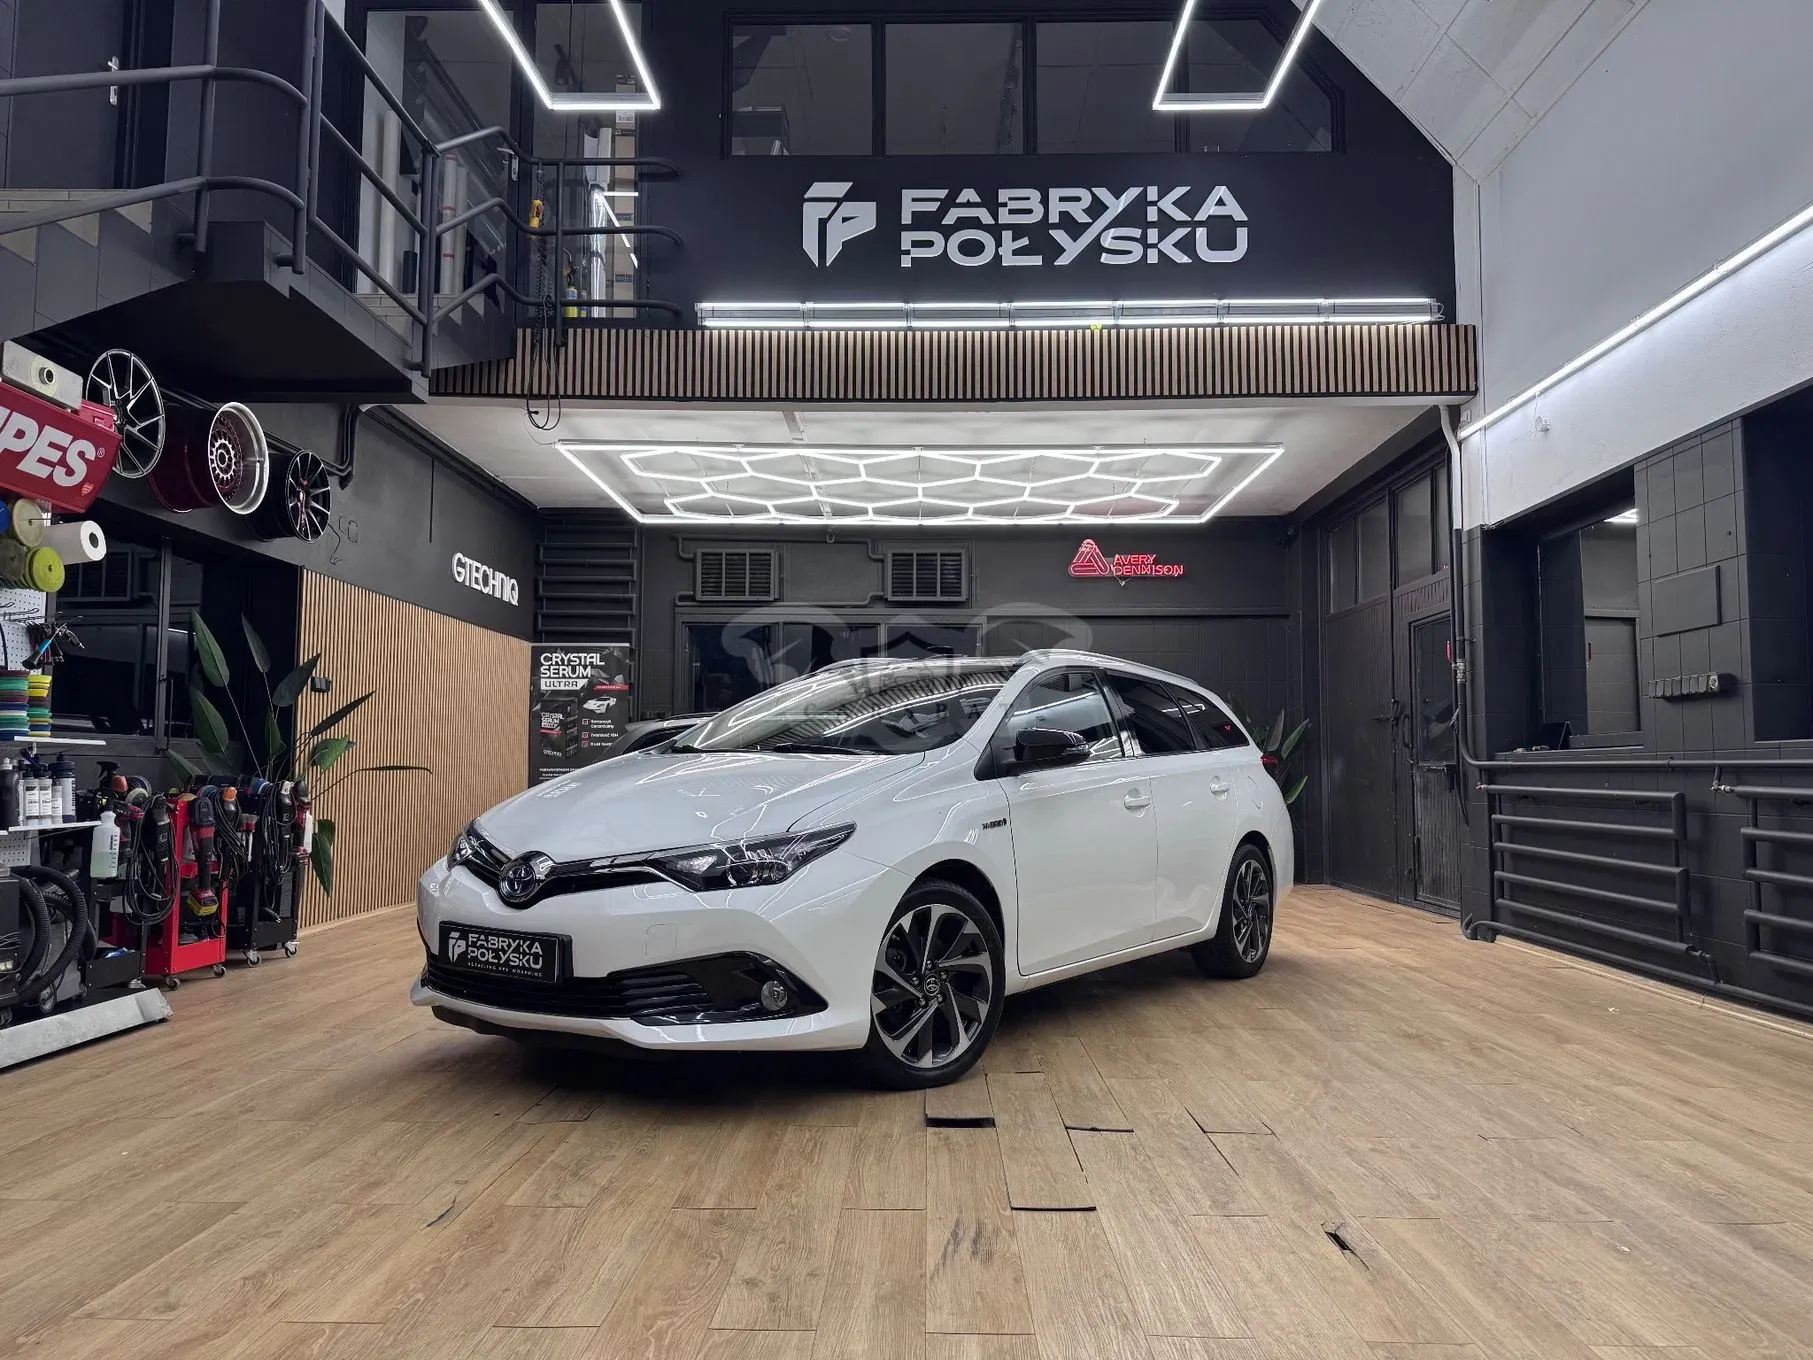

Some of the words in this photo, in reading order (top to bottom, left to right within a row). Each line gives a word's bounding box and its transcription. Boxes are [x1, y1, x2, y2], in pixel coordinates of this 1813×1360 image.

[900, 185, 1248, 225] FABRYKA
[900, 225, 1248, 268] POŁYSKU
[1113, 553, 1157, 564] AVERY
[1113, 564, 1184, 576] DENNISON
[452, 552, 519, 607] GTECHNIQ
[540, 652, 605, 666] CRYSTAL
[540, 665, 591, 678] SERUM
[544, 680, 578, 688] ULTRA
[468, 933, 544, 955] FABRYKA
[467, 947, 543, 969] POŁYSKU
